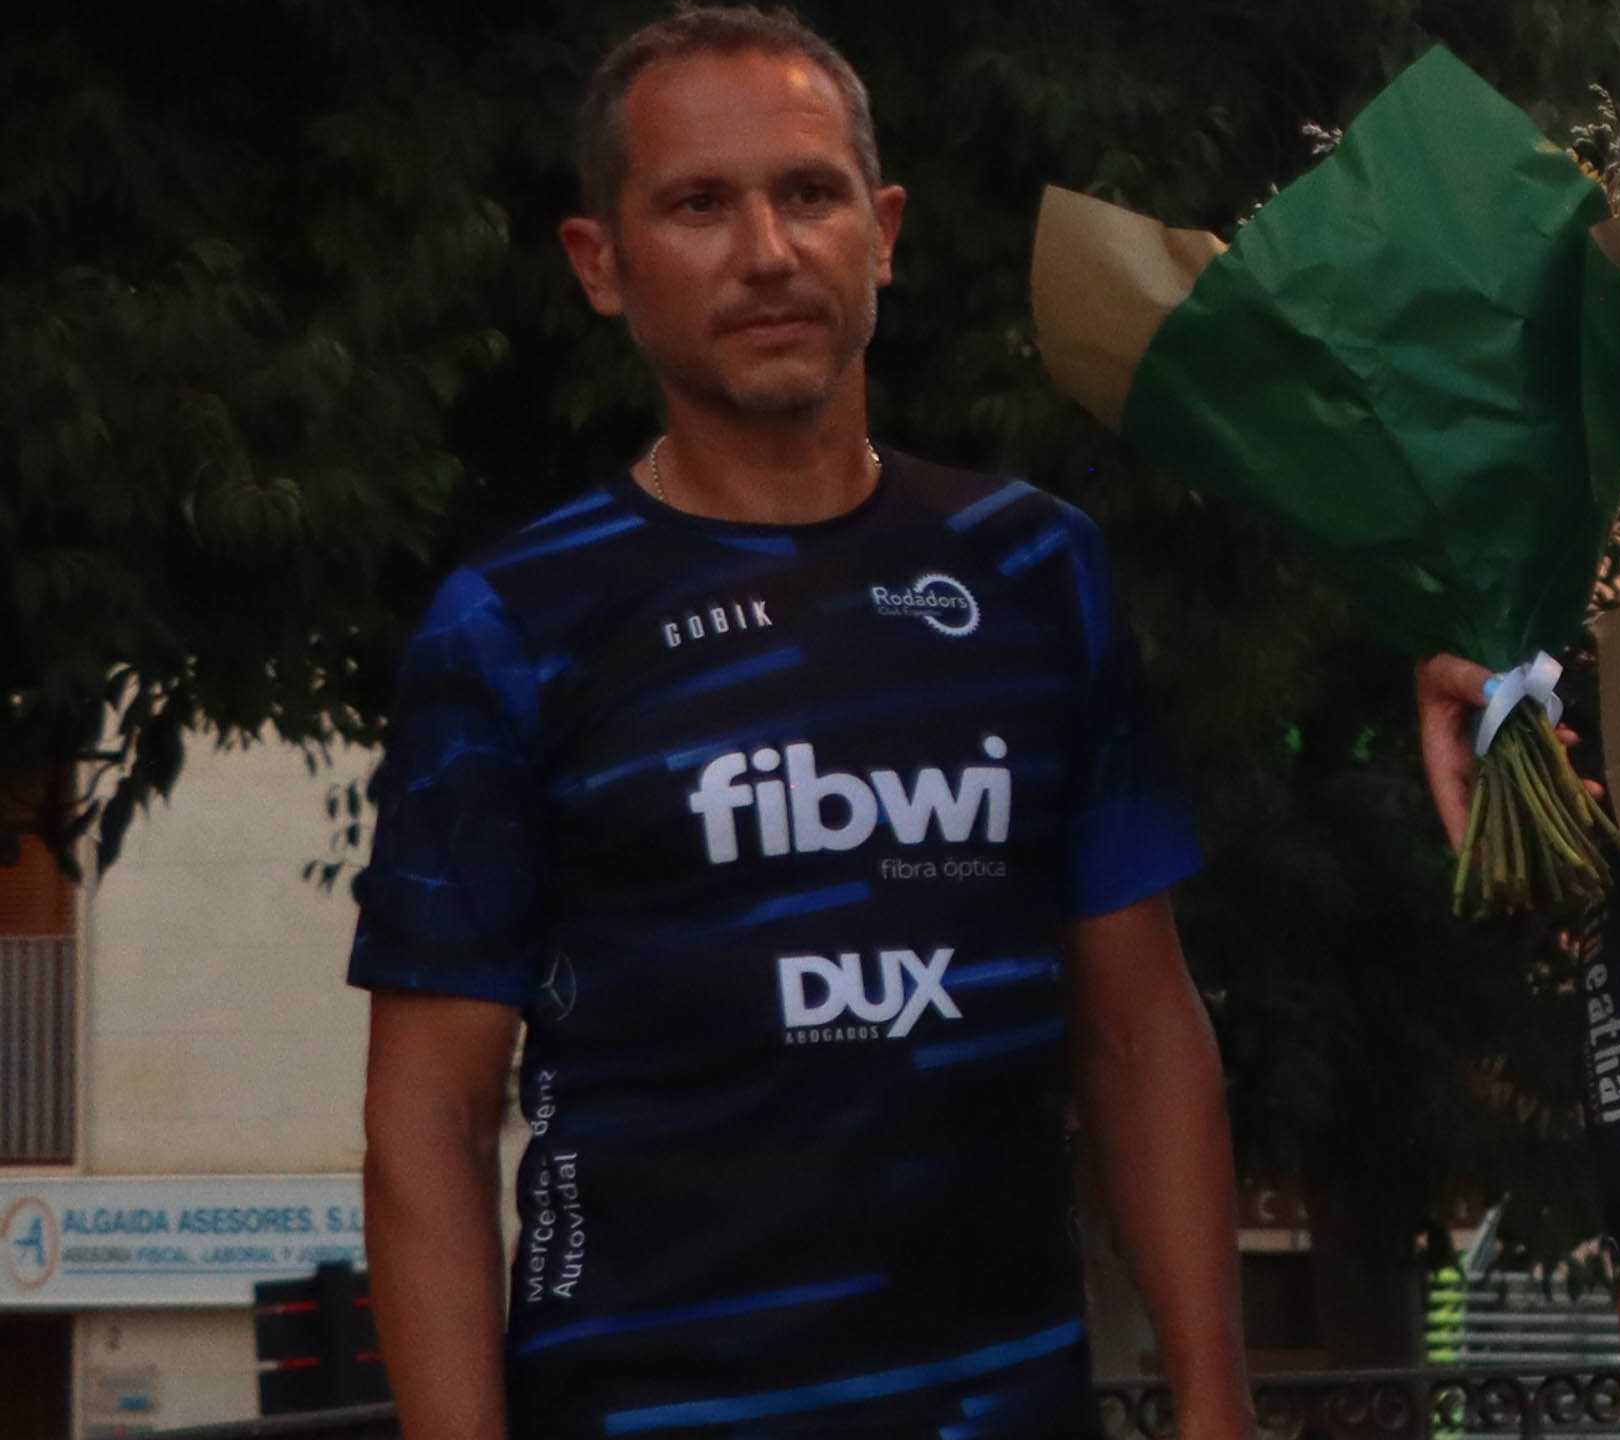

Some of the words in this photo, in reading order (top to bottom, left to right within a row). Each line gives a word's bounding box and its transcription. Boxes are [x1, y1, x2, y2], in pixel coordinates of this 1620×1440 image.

[869, 585, 970, 610] Rodadors
[662, 599, 774, 649] GOBIK
[687, 734, 1013, 865] fibwi
[880, 856, 938, 880] fibra
[775, 947, 964, 1041] DUX
[784, 1024, 881, 1046] ABOGADOS
[526, 1068, 559, 1303] MercedeBenz
[63, 1207, 170, 1234] ALGAIDA
[552, 1152, 585, 1300] Autovidal
